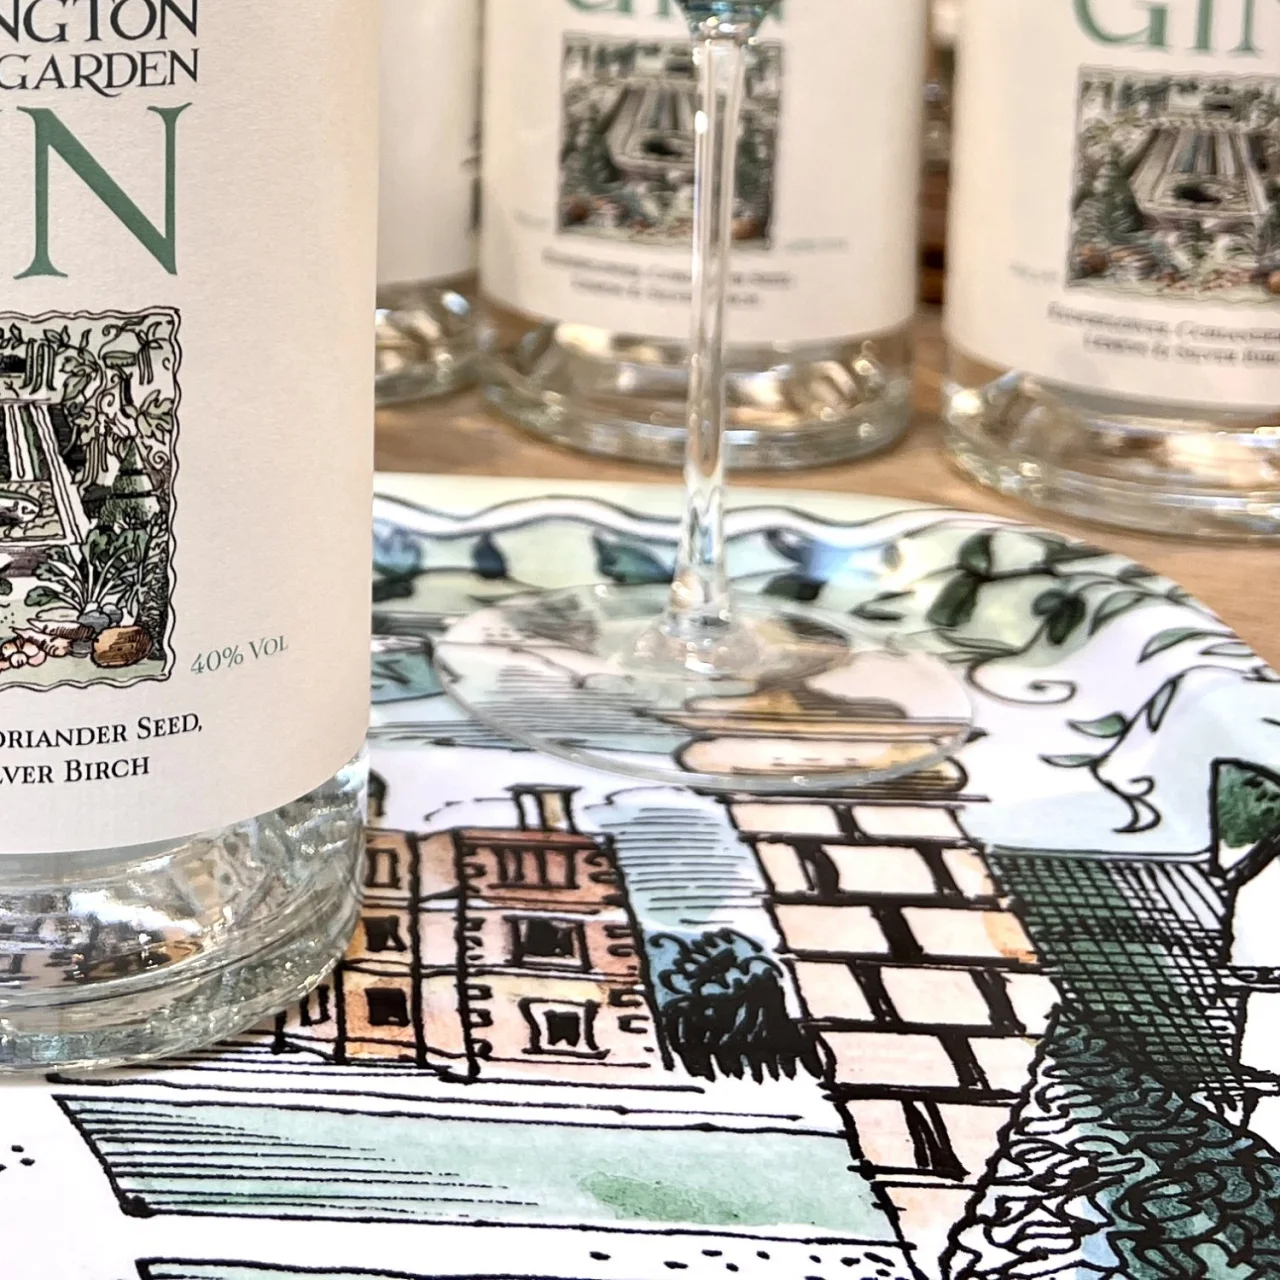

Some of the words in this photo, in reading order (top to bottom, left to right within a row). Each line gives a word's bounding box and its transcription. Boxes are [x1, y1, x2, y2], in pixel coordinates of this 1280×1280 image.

[190, 644, 244, 675] 40%
[137, 712, 203, 739] SEED,
[64, 756, 151, 783] BIRCH
